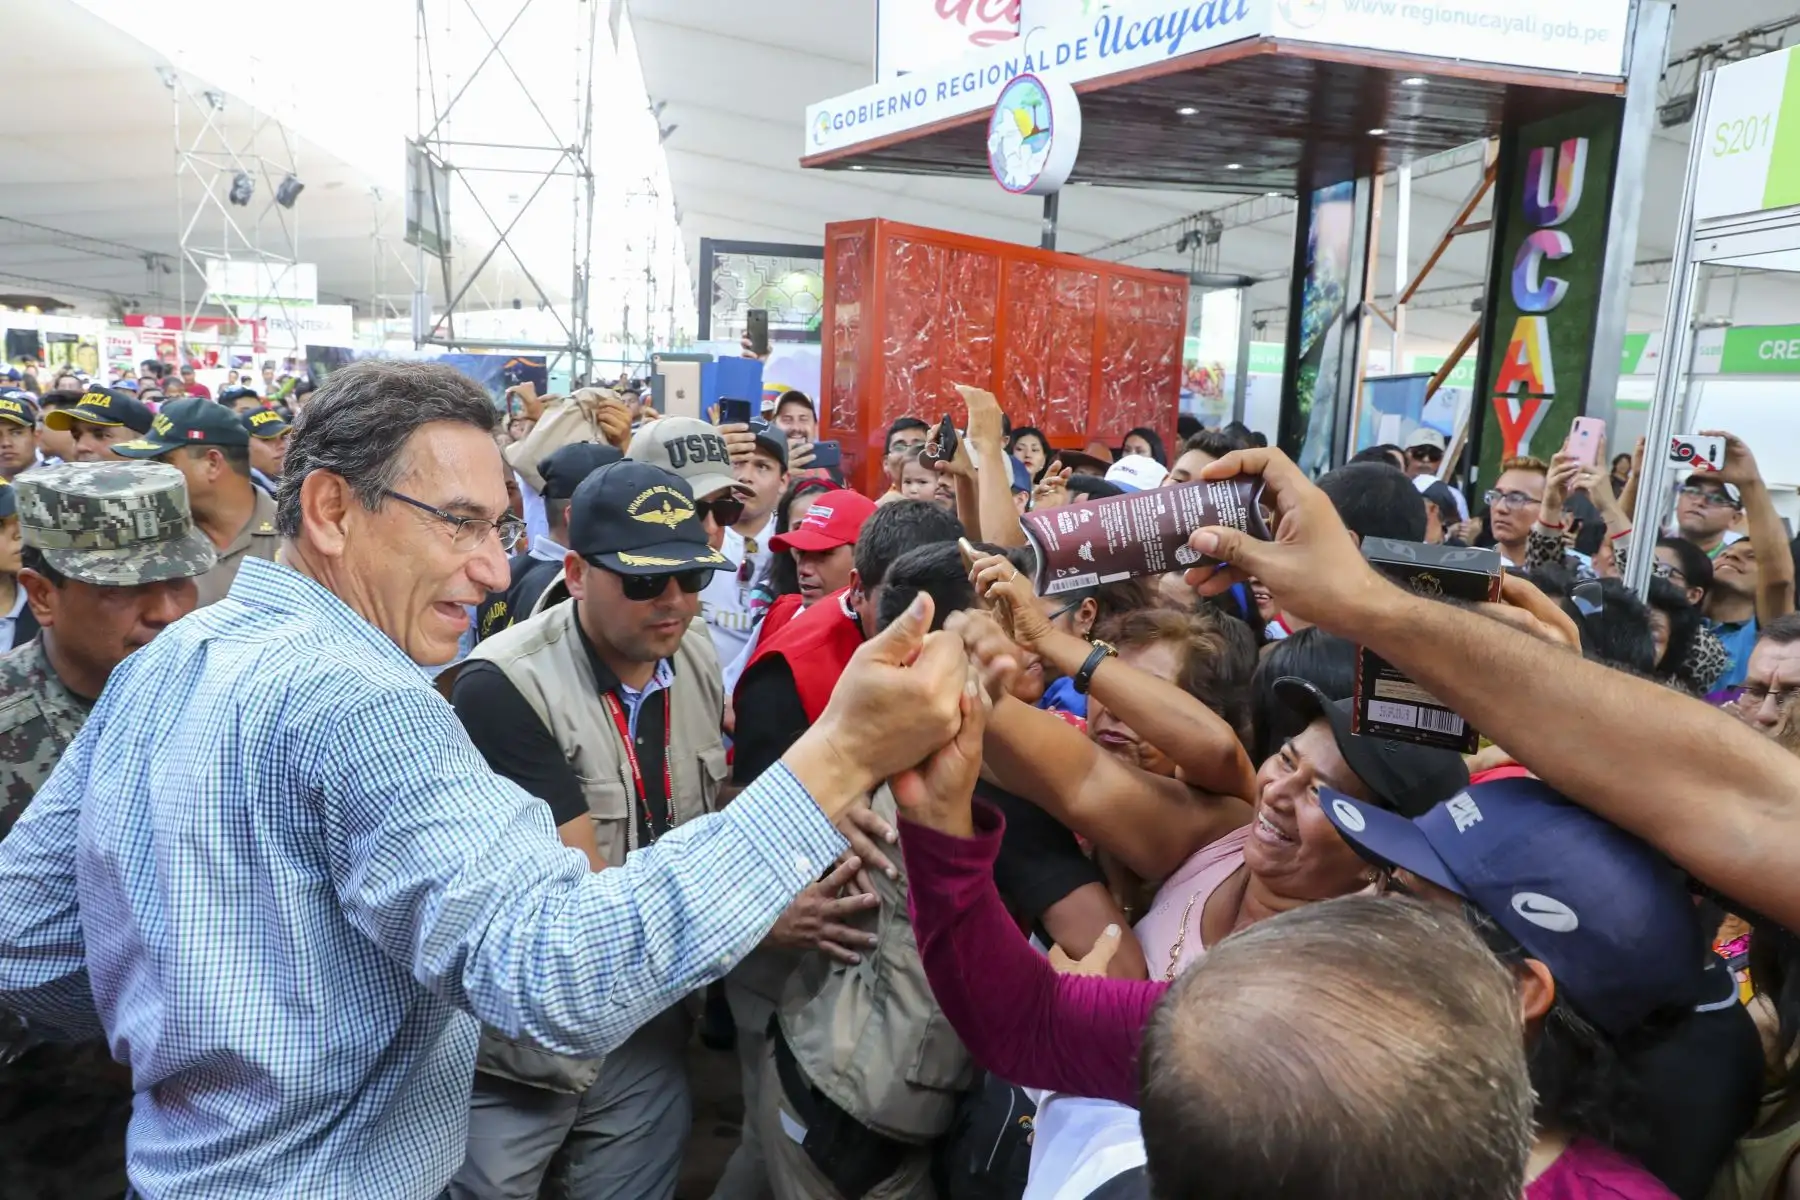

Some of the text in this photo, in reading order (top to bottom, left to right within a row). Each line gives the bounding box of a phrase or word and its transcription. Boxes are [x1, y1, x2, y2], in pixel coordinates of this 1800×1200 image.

[832, 87, 927, 131] GOBIERNO
[936, 50, 1050, 103] REGIONAL
[1055, 37, 1088, 66] DE
[1711, 111, 1772, 158] S201
